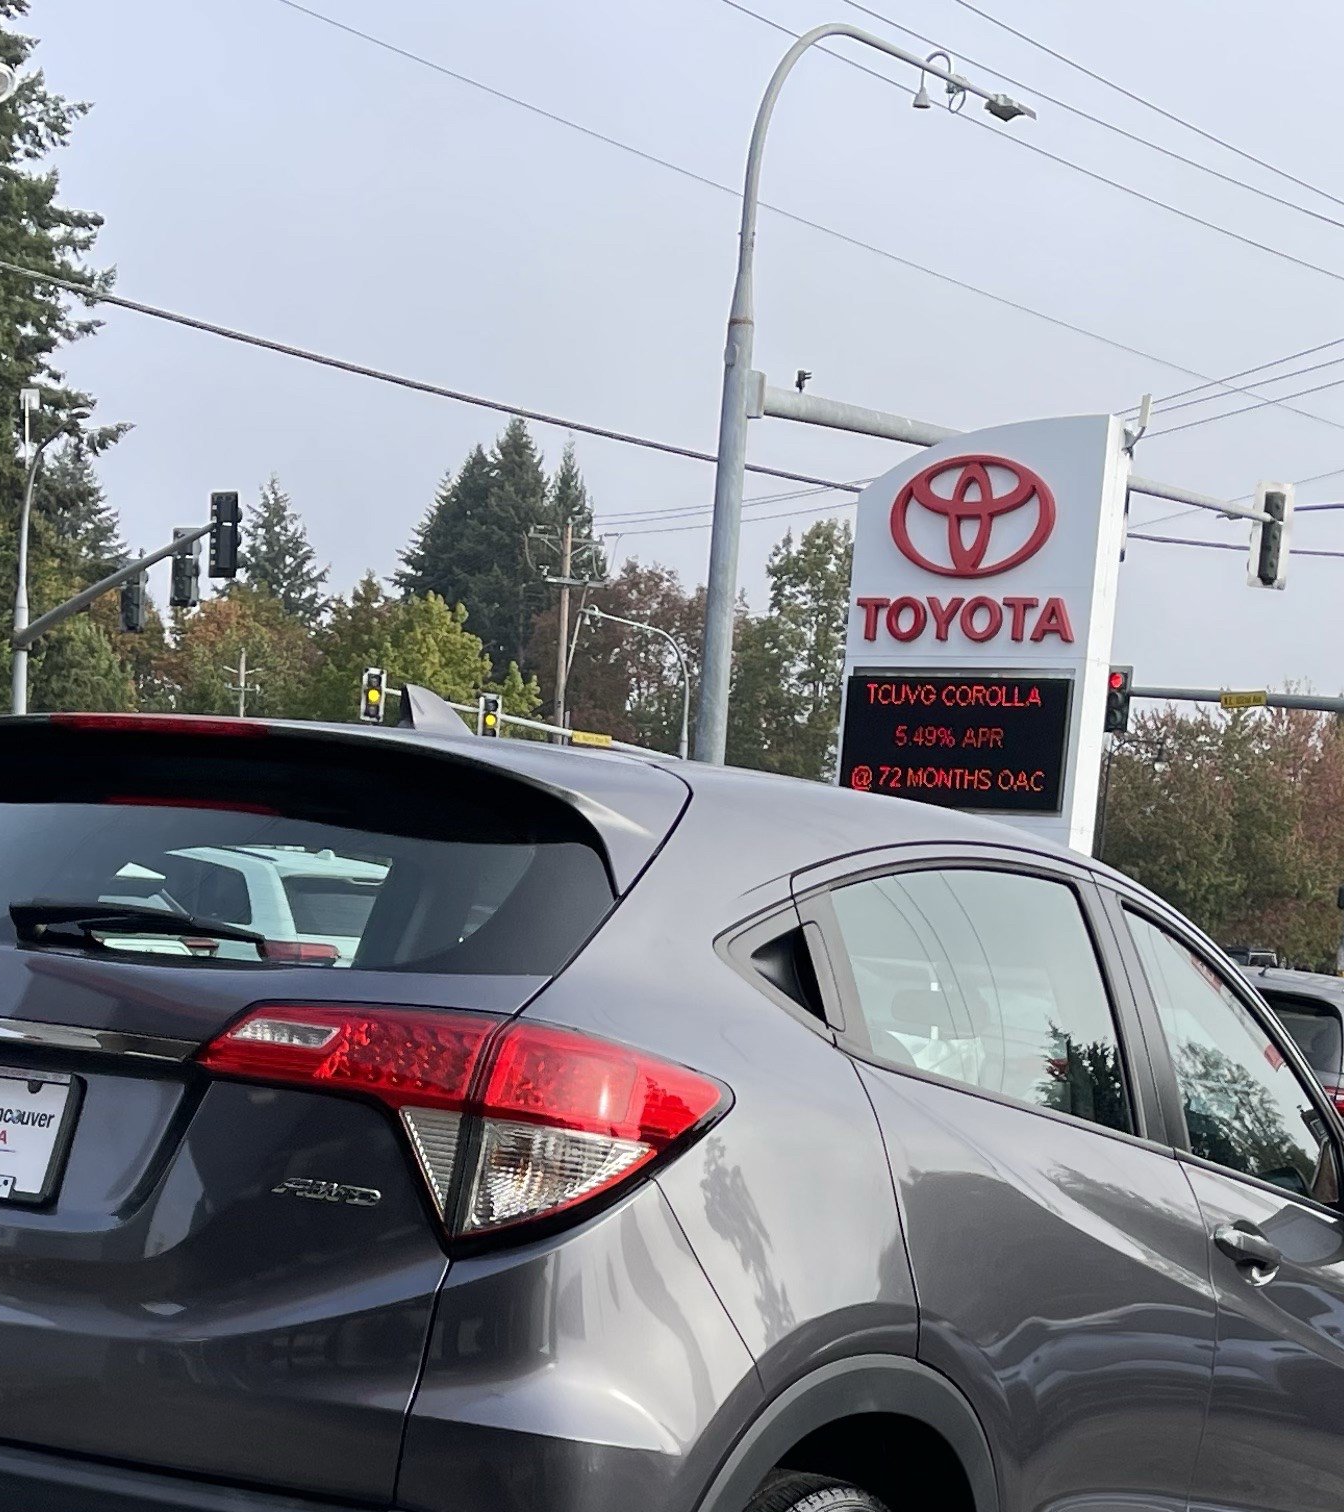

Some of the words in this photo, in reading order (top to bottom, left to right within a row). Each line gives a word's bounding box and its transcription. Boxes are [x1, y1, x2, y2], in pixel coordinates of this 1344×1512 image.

[857, 595, 1075, 643] TOYOTA
[942, 684, 1042, 708] COROLLA
[895, 725, 956, 748] 5.49%
[962, 727, 1004, 749] APR
[851, 765, 873, 791] @
[878, 766, 902, 788] 72
[907, 767, 992, 790] MONTHS
[998, 770, 1046, 792] OAC
